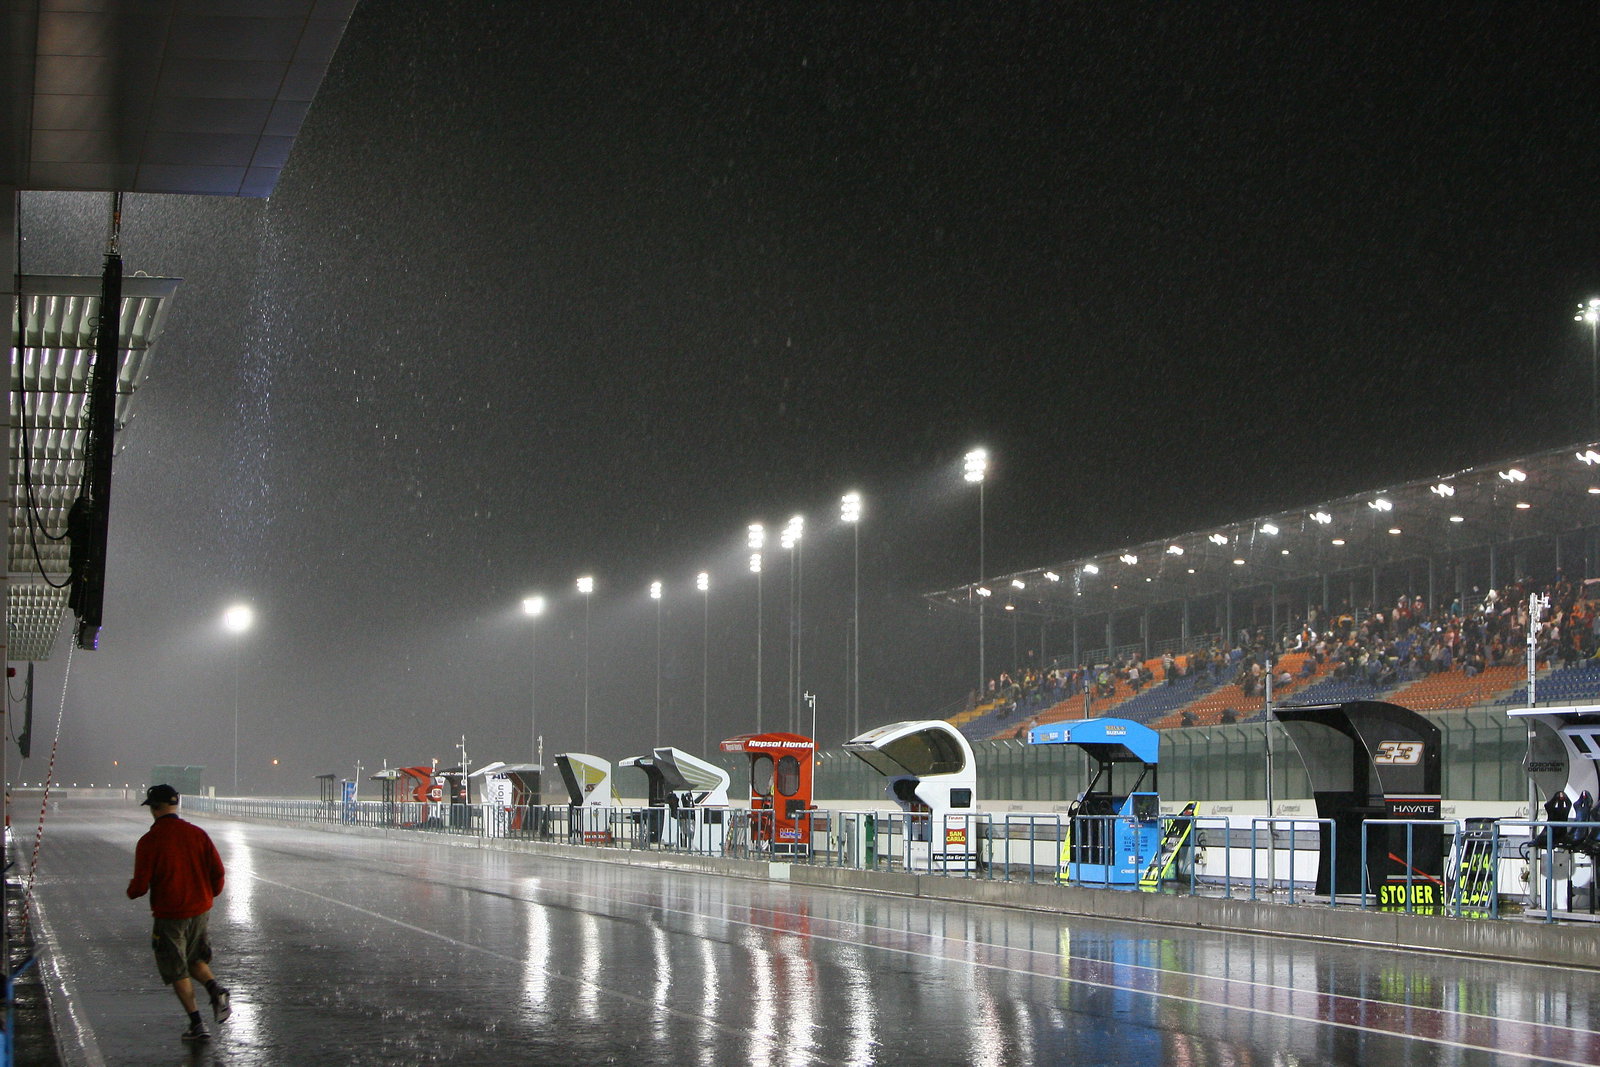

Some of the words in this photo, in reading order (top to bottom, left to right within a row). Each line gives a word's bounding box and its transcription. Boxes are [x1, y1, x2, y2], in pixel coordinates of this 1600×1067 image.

[748, 740, 781, 748] Repsol
[782, 742, 814, 750] Honda
[1374, 741, 1424, 765] 33
